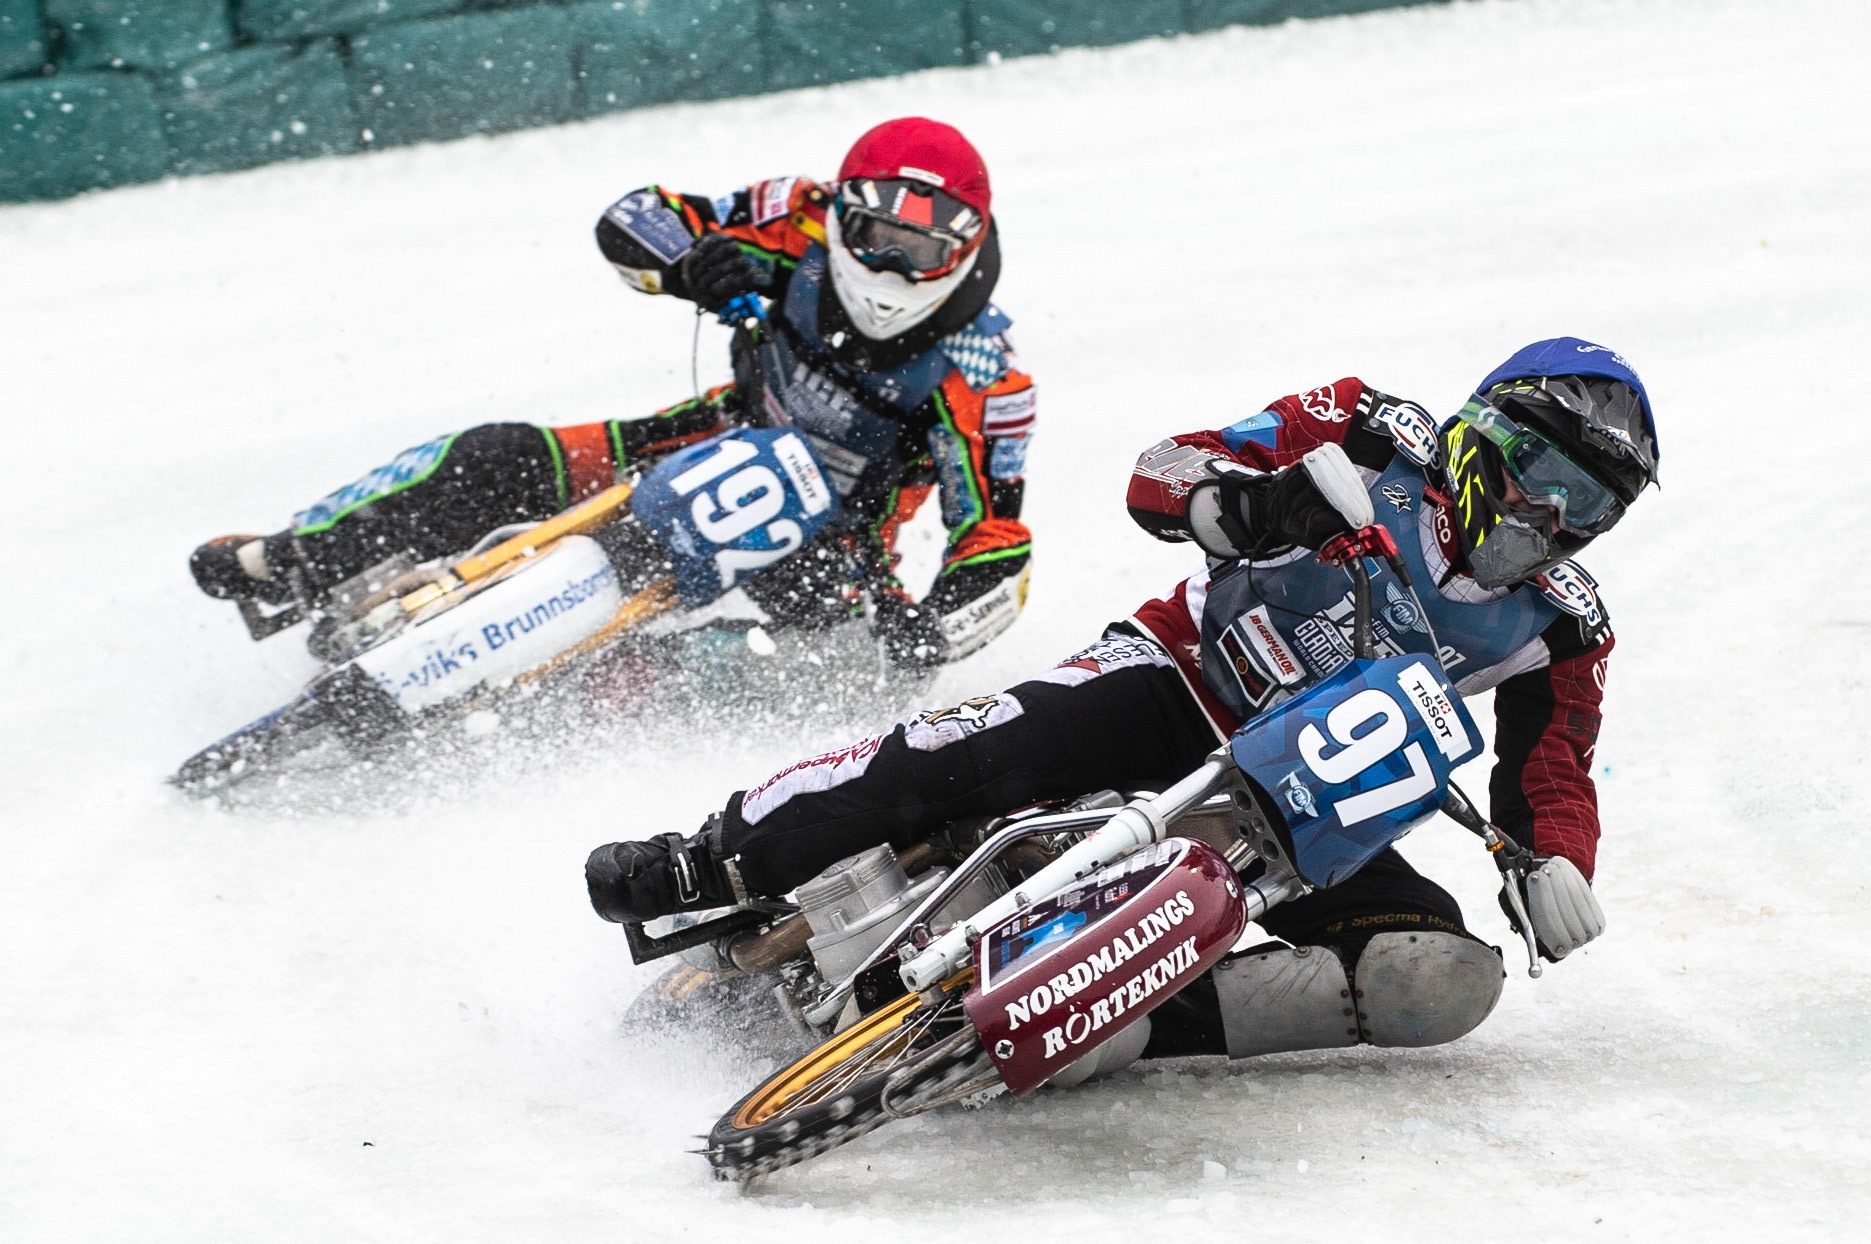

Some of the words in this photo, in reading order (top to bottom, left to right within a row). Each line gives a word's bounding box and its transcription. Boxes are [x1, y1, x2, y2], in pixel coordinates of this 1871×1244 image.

[1379, 406, 1442, 470] FUCHS
[669, 439, 803, 588] 192
[1392, 604, 1413, 625] FIM
[1549, 567, 1600, 624] UCHS
[377, 642, 478, 699] -viks
[1256, 623, 1288, 662] GERMAN
[1281, 660, 1297, 676] OIL
[1309, 661, 1325, 677] CHAM
[1413, 680, 1452, 738] TISSOT
[1297, 688, 1438, 828] 97
[1293, 788, 1307, 806] FIM
[1352, 913, 1421, 927] Specma
[1005, 890, 1195, 1030] NORDMALINGS
[1043, 936, 1199, 1058] RÖRTEKNIK
